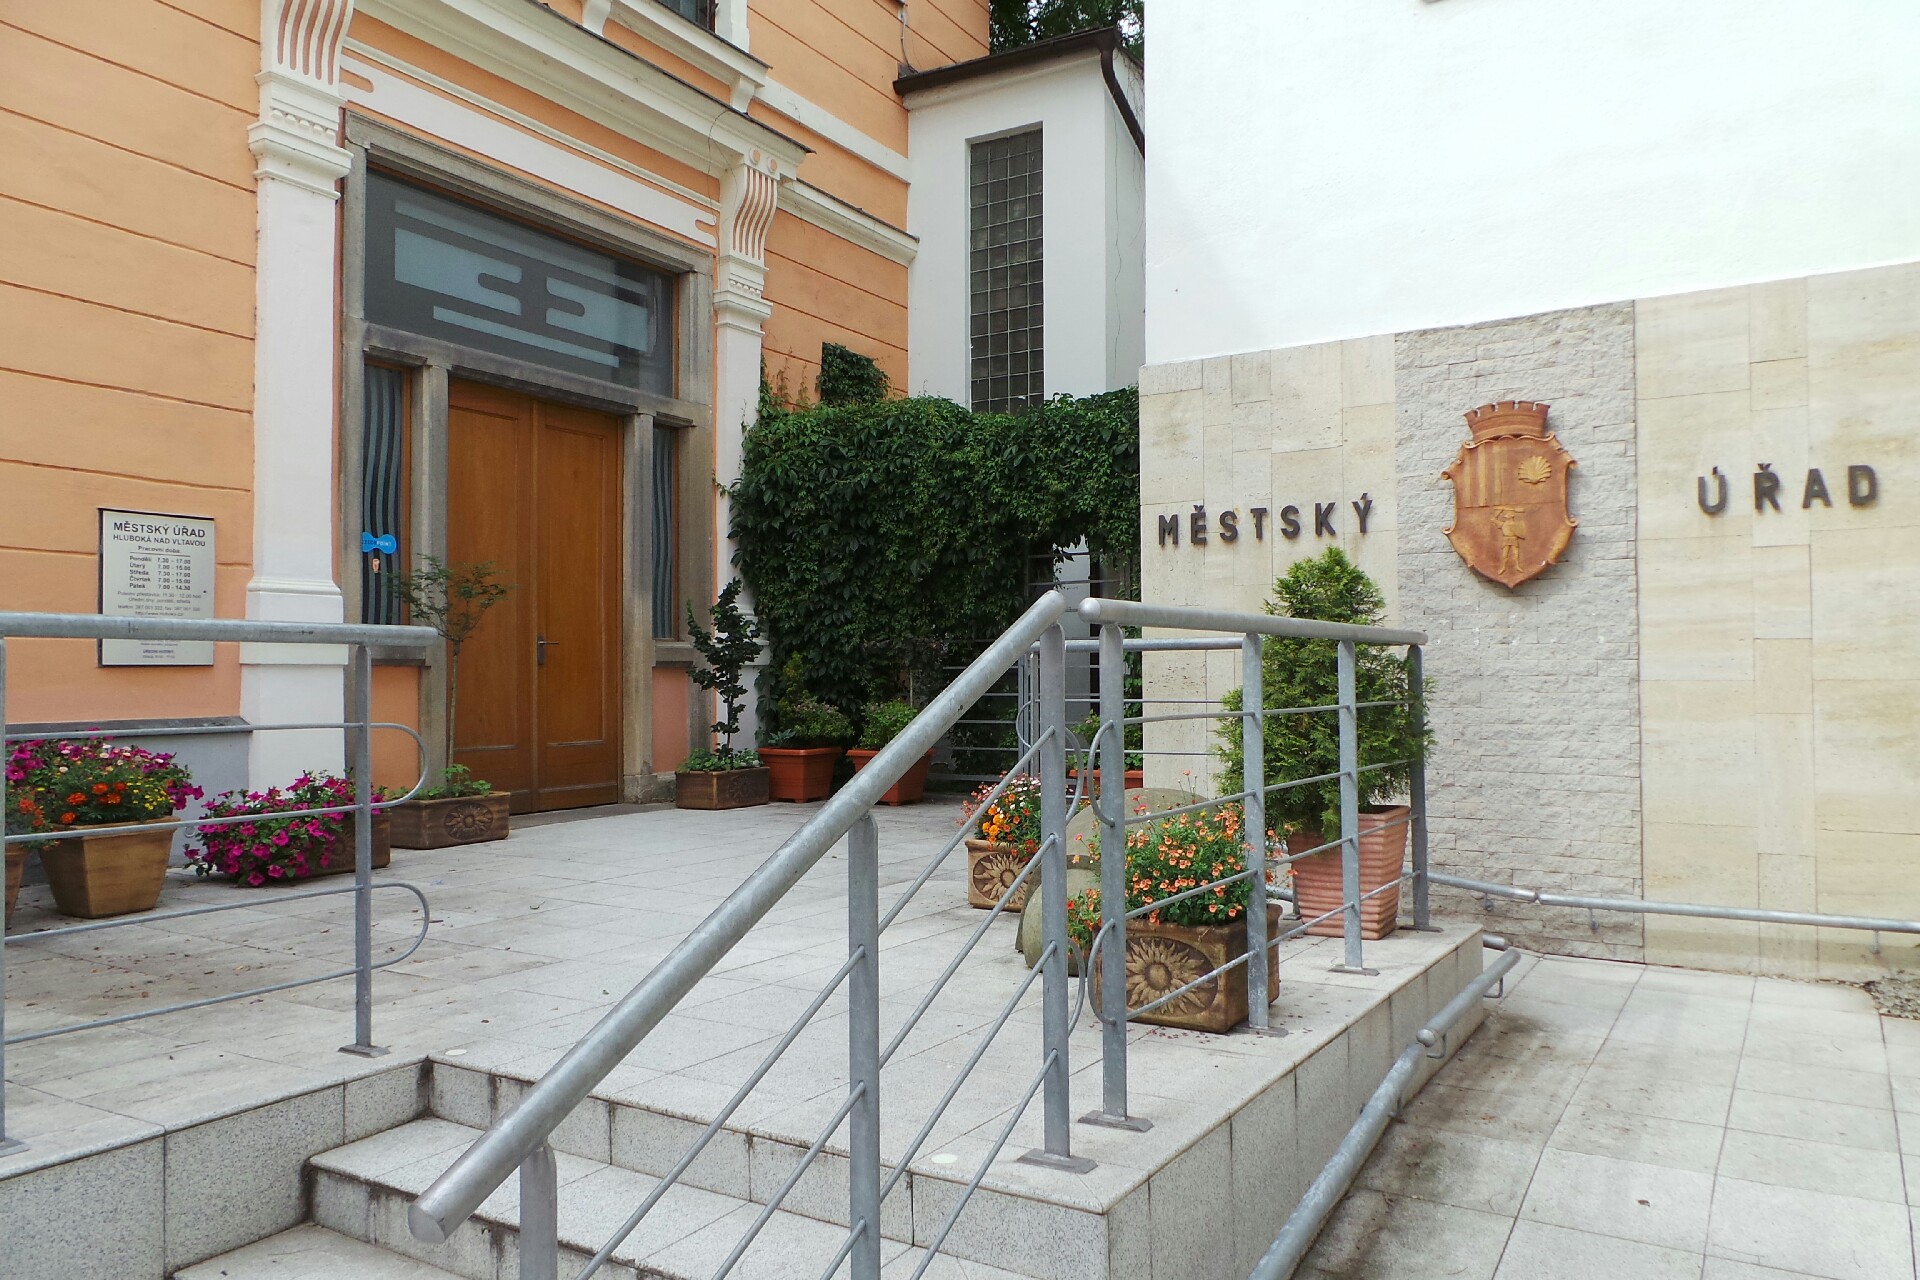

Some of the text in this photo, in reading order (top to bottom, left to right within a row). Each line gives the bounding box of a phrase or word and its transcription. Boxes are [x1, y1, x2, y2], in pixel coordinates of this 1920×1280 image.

[1158, 463, 1878, 546] MĚSTSKÝ ÚŘAD
[113, 520, 206, 538] MĚSTSKÝ ÚŘAD
[113, 534, 151, 543] HLUBOKÁ
[172, 538, 206, 547] VLTAVOU
